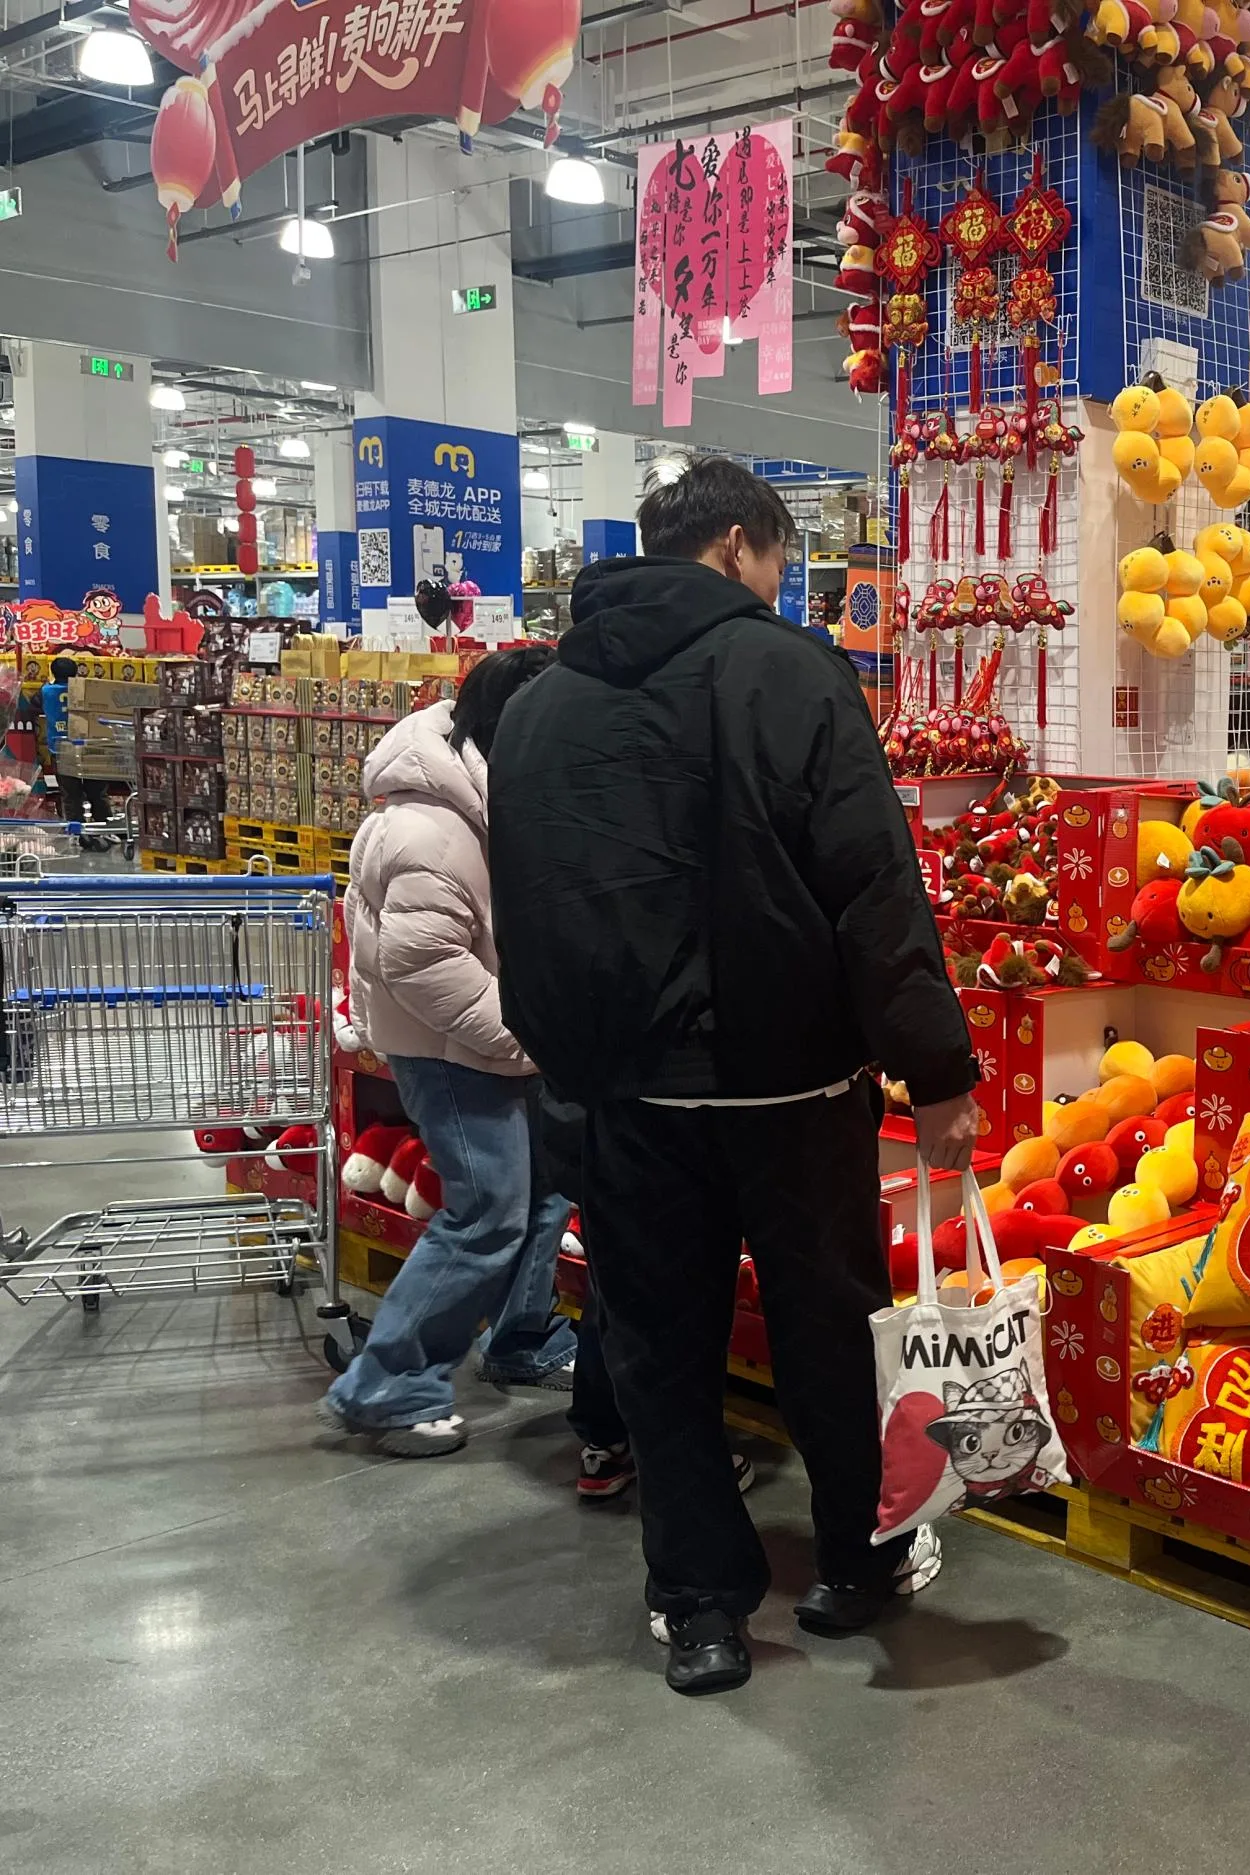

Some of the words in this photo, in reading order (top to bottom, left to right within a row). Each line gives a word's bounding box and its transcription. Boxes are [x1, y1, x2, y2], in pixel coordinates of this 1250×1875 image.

[701, 137, 723, 315] 爱你一万年
[959, 208, 986, 239] 福
[1020, 207, 1047, 238] 福
[893, 234, 917, 267] 福
[356, 479, 389, 497] 扫码下载
[407, 478, 455, 499] 麦德龙
[464, 486, 501, 504] APP
[408, 498, 502, 524] 全城无忧配送
[91, 514, 111, 560] 零食
[14, 618, 78, 643] 旺旺
[902, 1309, 1030, 1370] MiMiCAT
